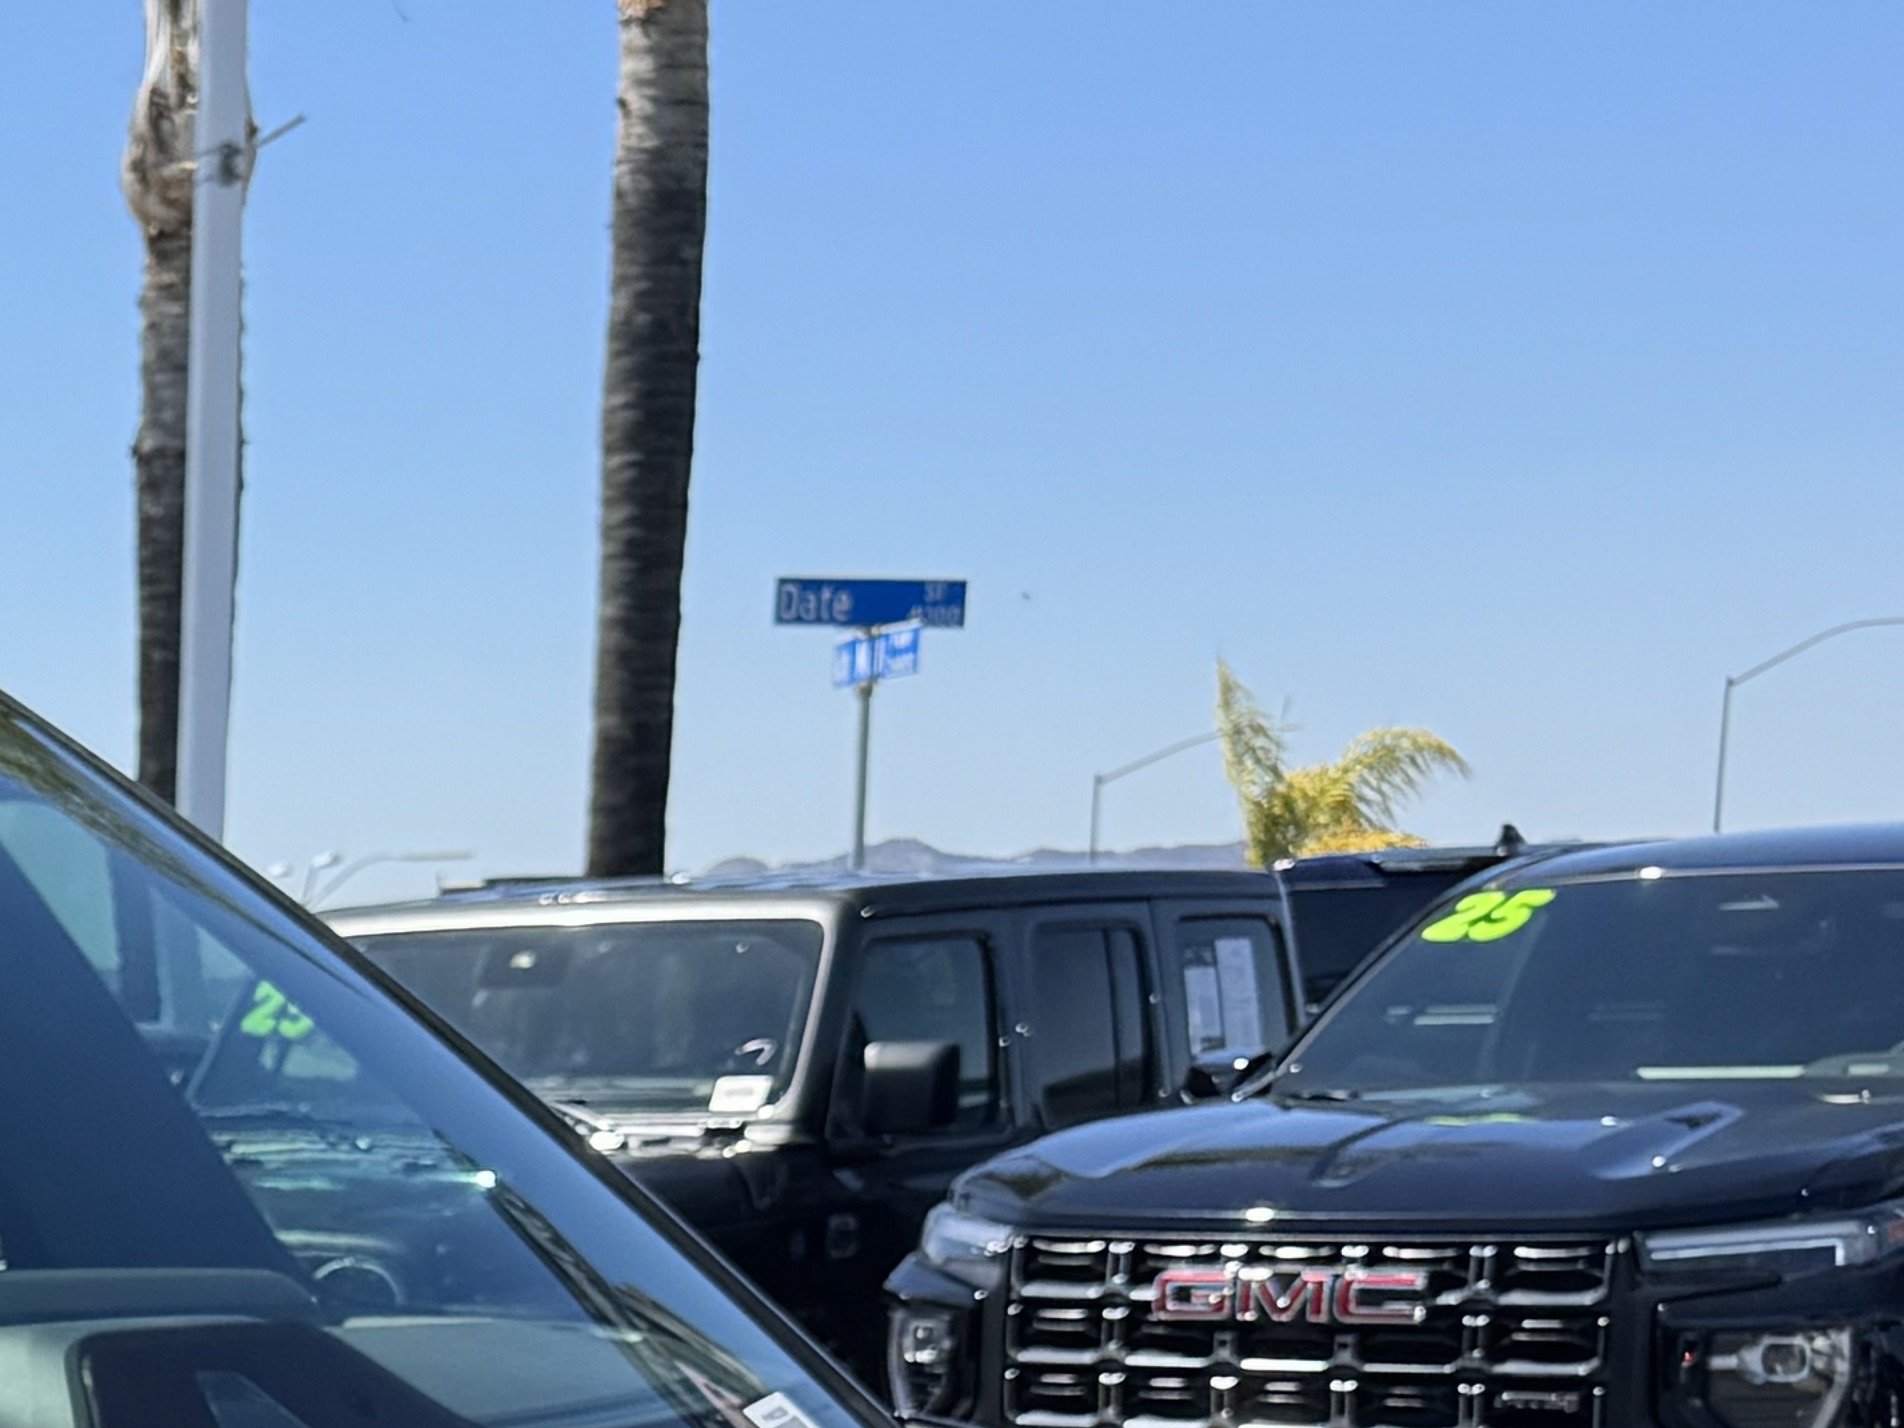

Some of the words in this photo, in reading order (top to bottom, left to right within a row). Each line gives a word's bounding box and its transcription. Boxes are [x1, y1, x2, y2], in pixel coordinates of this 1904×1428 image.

[778, 582, 853, 621] Date
[1420, 888, 1557, 943] 25
[1151, 1267, 1430, 1325] GMC
